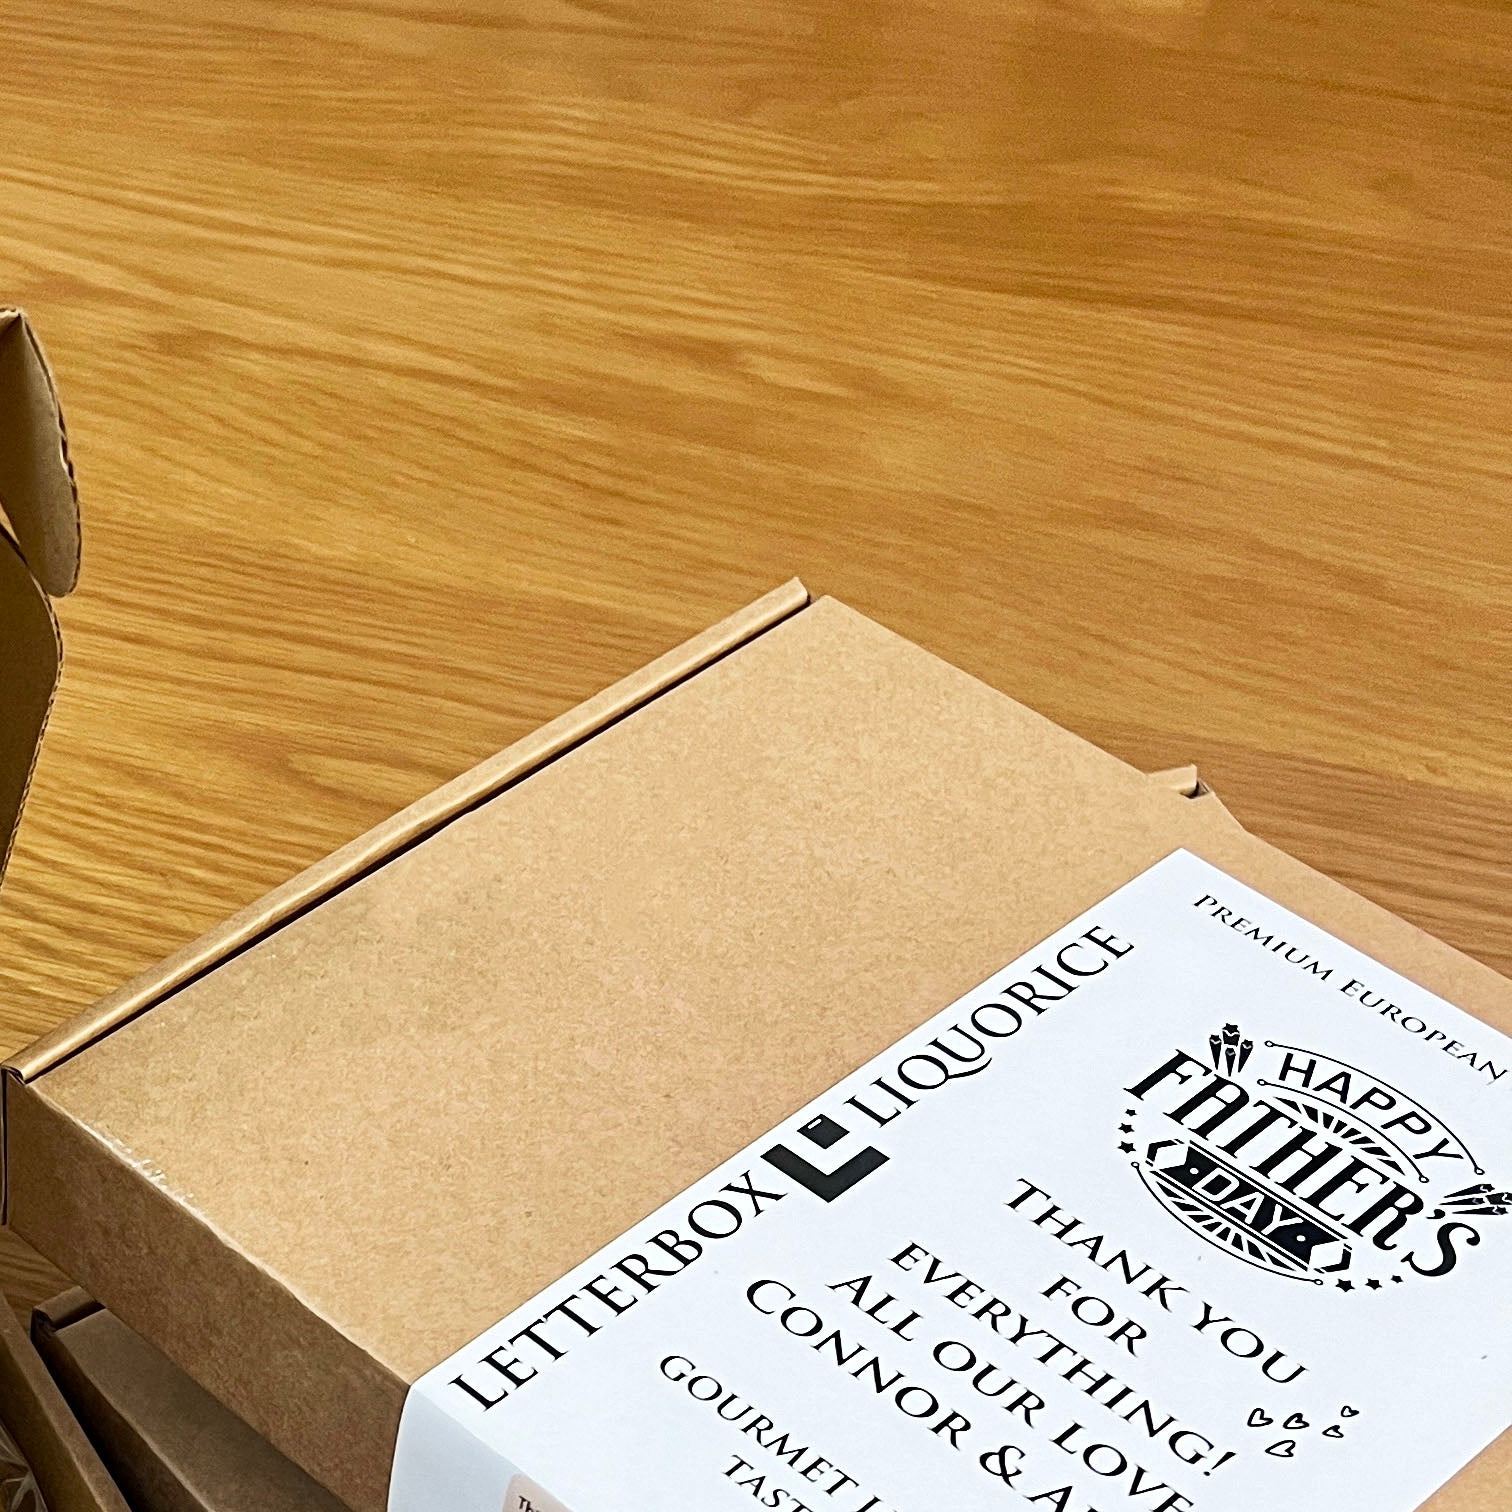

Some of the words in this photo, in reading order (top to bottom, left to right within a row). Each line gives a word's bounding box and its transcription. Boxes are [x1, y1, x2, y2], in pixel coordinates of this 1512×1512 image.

[1193, 893, 1333, 982] PREMIUM
[1340, 978, 1509, 1086] EUROPEAN
[447, 1170, 788, 1412] LETTERBOX
[844, 925, 1136, 1130] LIQUORICE
[1123, 1048, 1481, 1277] FATHER'S
[1278, 1052, 1464, 1160] HAPPY
[1003, 1178, 1190, 1313] THANK
[1190, 1301, 1310, 1384] YOU
[1195, 1172, 1303, 1237] DAY
[745, 1278, 973, 1451] CONNOR
[978, 1445, 1024, 1488] &
[825, 1274, 918, 1342] ALL
[932, 1339, 1046, 1427] OUR
[888, 1241, 1238, 1478] EVERYTHING!
[1040, 1274, 1148, 1357] FOR
[659, 1354, 860, 1498] GOURMET
